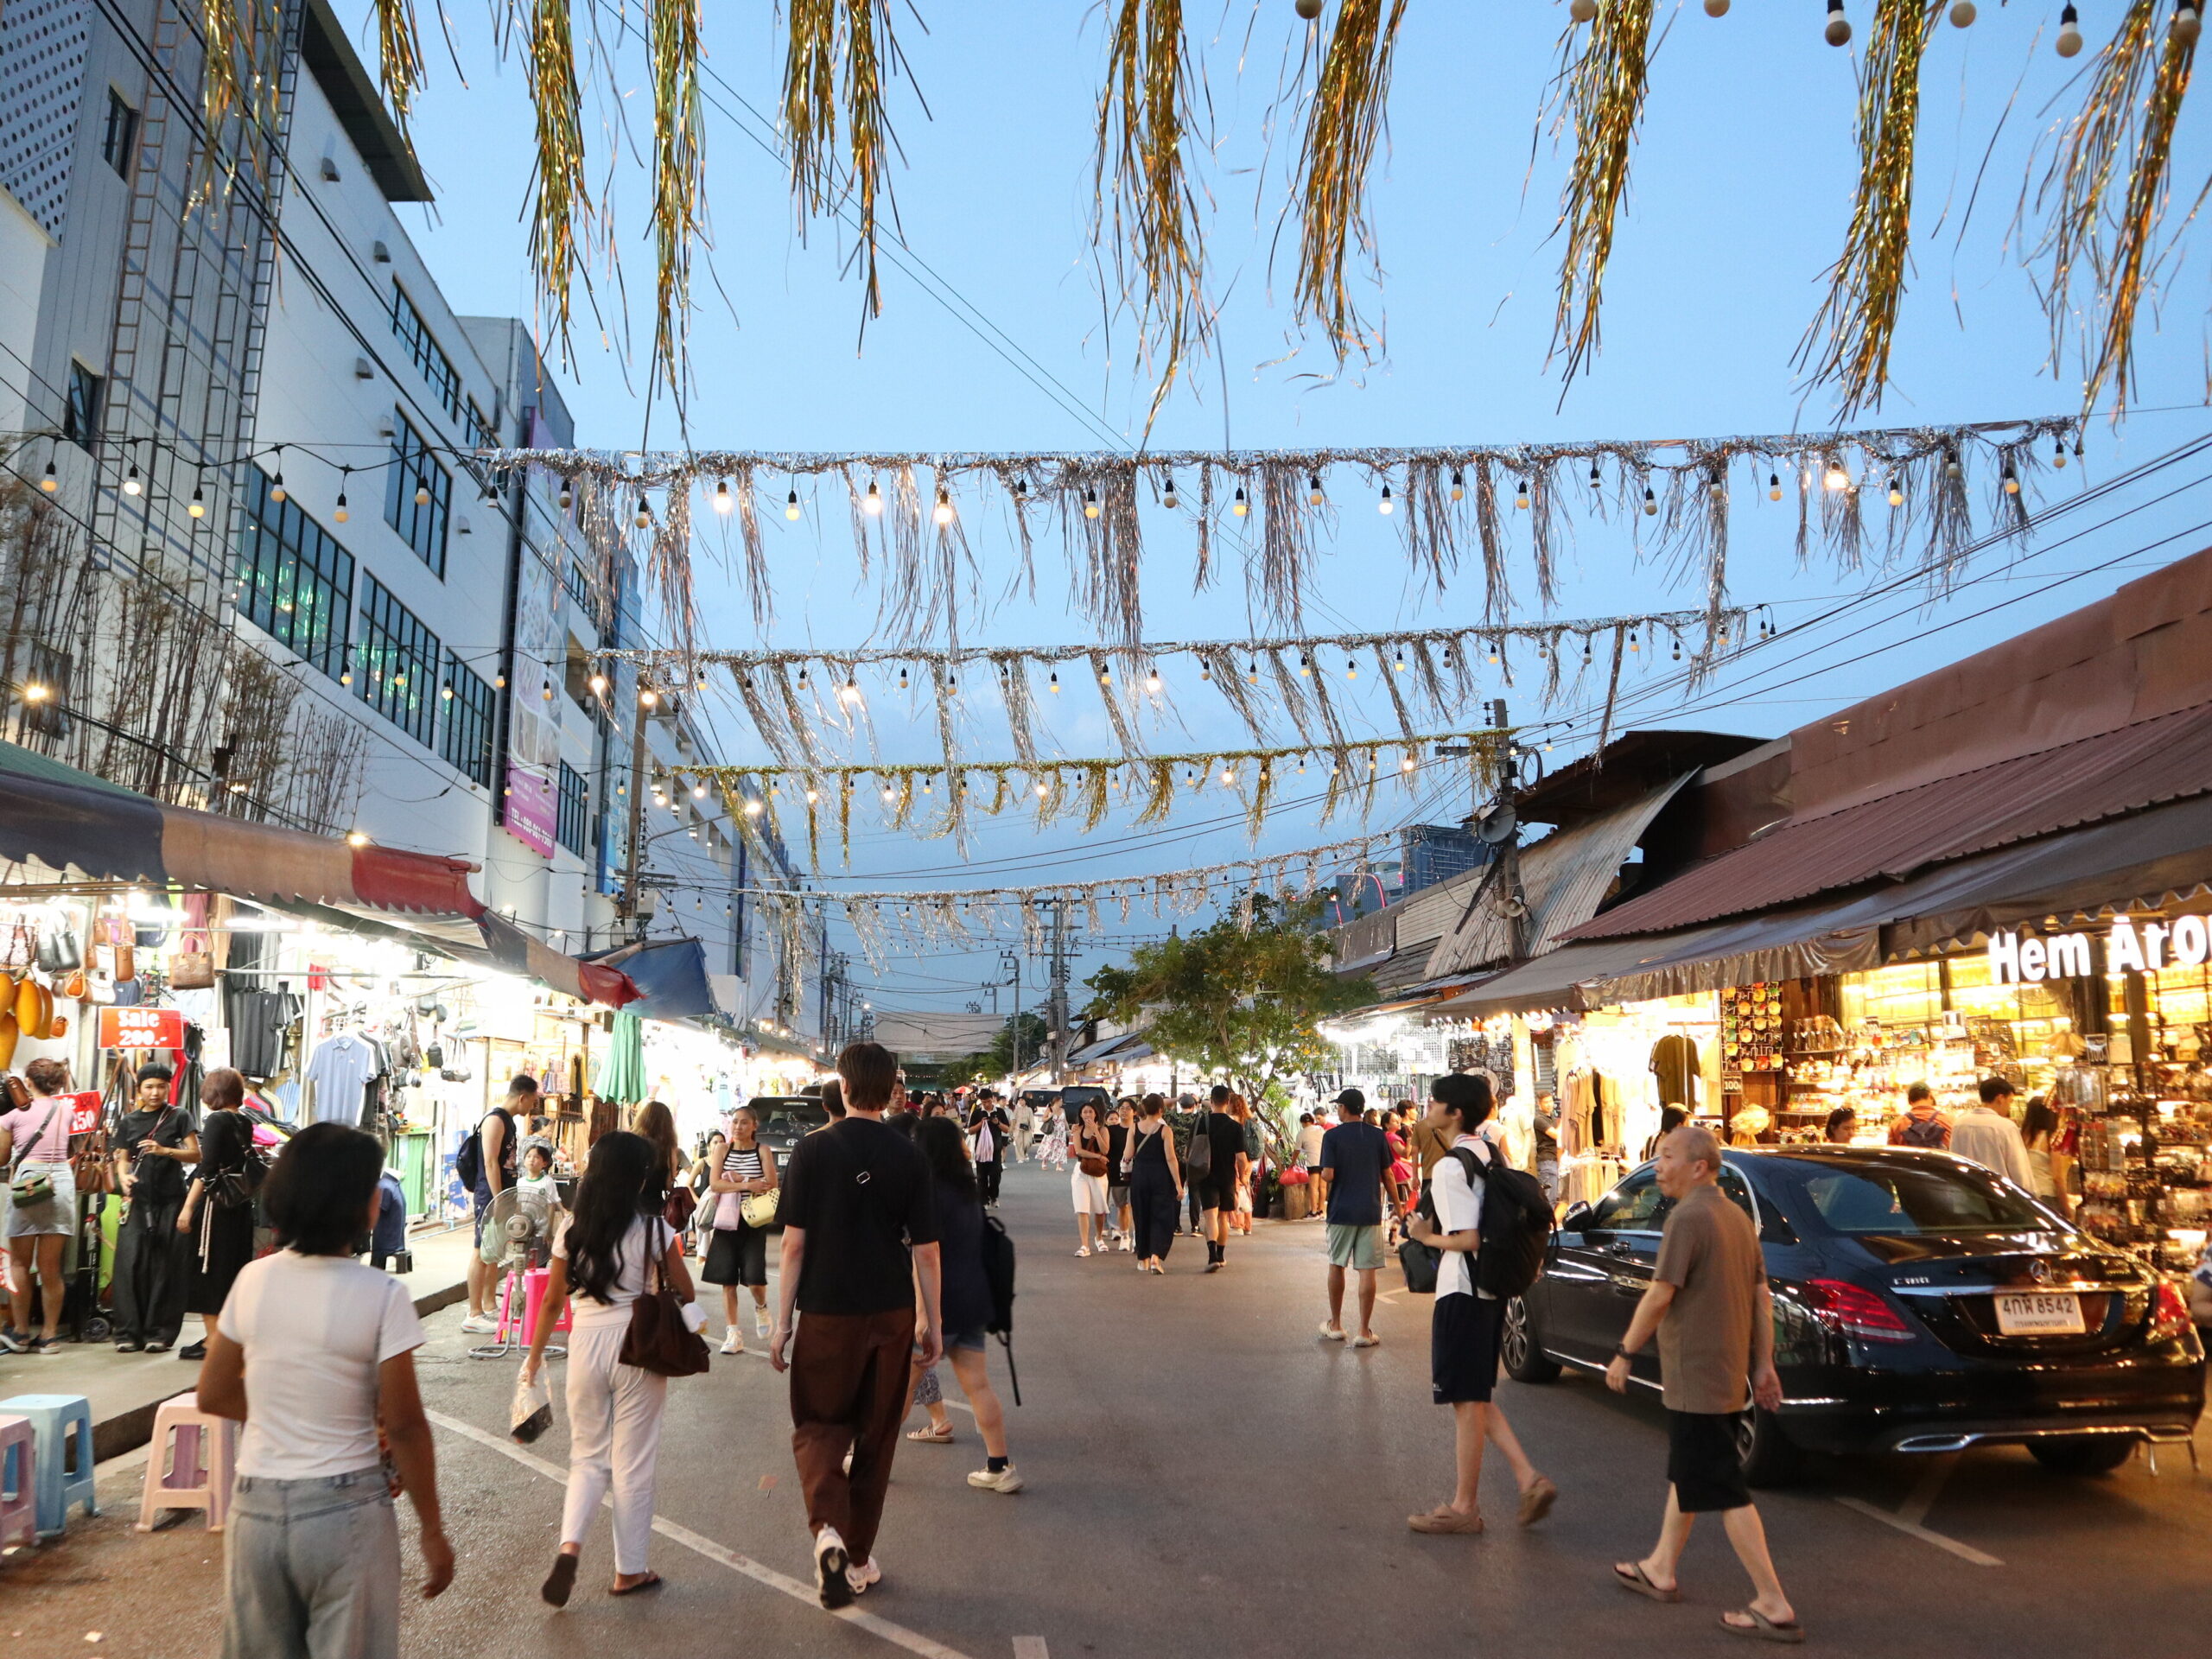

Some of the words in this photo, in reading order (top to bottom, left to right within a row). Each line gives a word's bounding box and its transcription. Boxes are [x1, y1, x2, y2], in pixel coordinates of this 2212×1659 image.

[1988, 930, 2091, 985] Hem
[2108, 915, 2212, 973] Aro
[118, 1009, 160, 1027] Sale
[118, 1029, 168, 1046] 200.-
[2036, 1297, 2074, 1313] 8542
